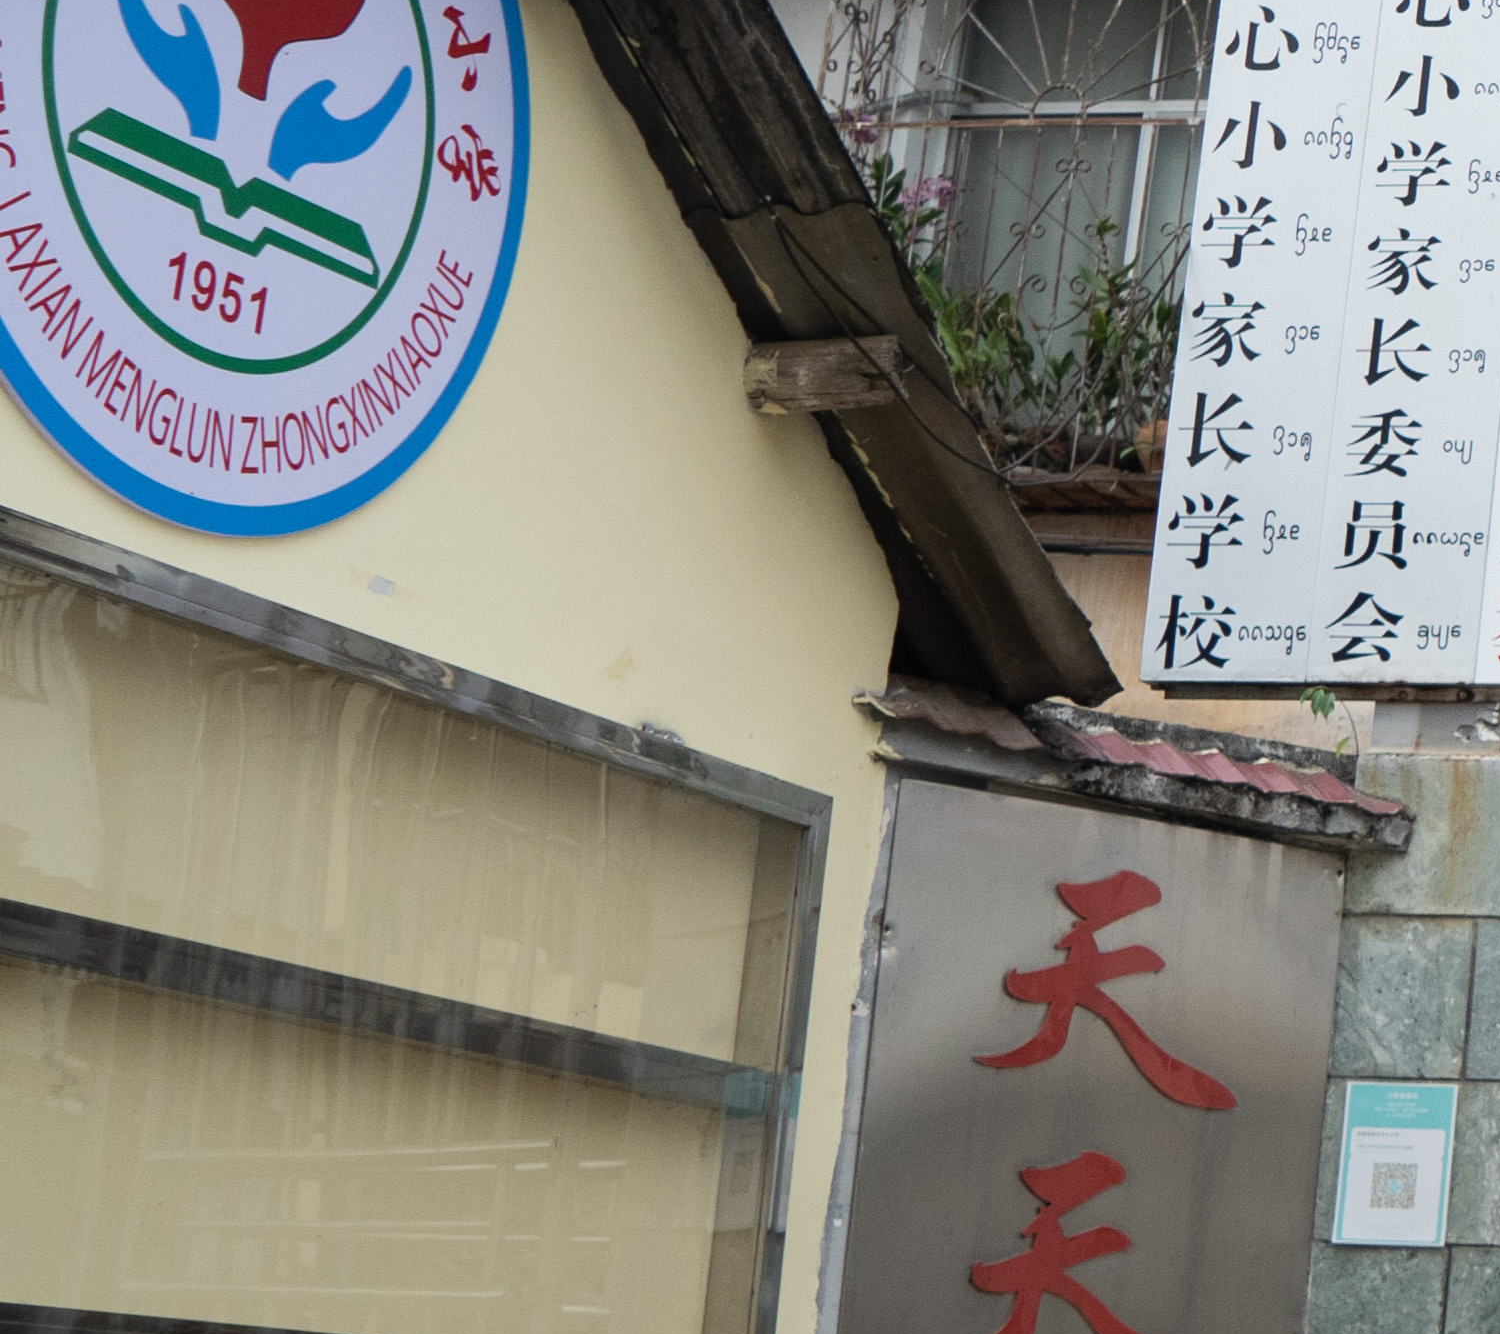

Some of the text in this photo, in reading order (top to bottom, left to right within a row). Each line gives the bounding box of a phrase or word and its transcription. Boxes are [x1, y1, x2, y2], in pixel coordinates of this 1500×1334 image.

[75, 329, 235, 472] MENGLUN
[240, 249, 474, 474] ZHONGXINXIAOXUE
[167, 250, 269, 335] 1951
